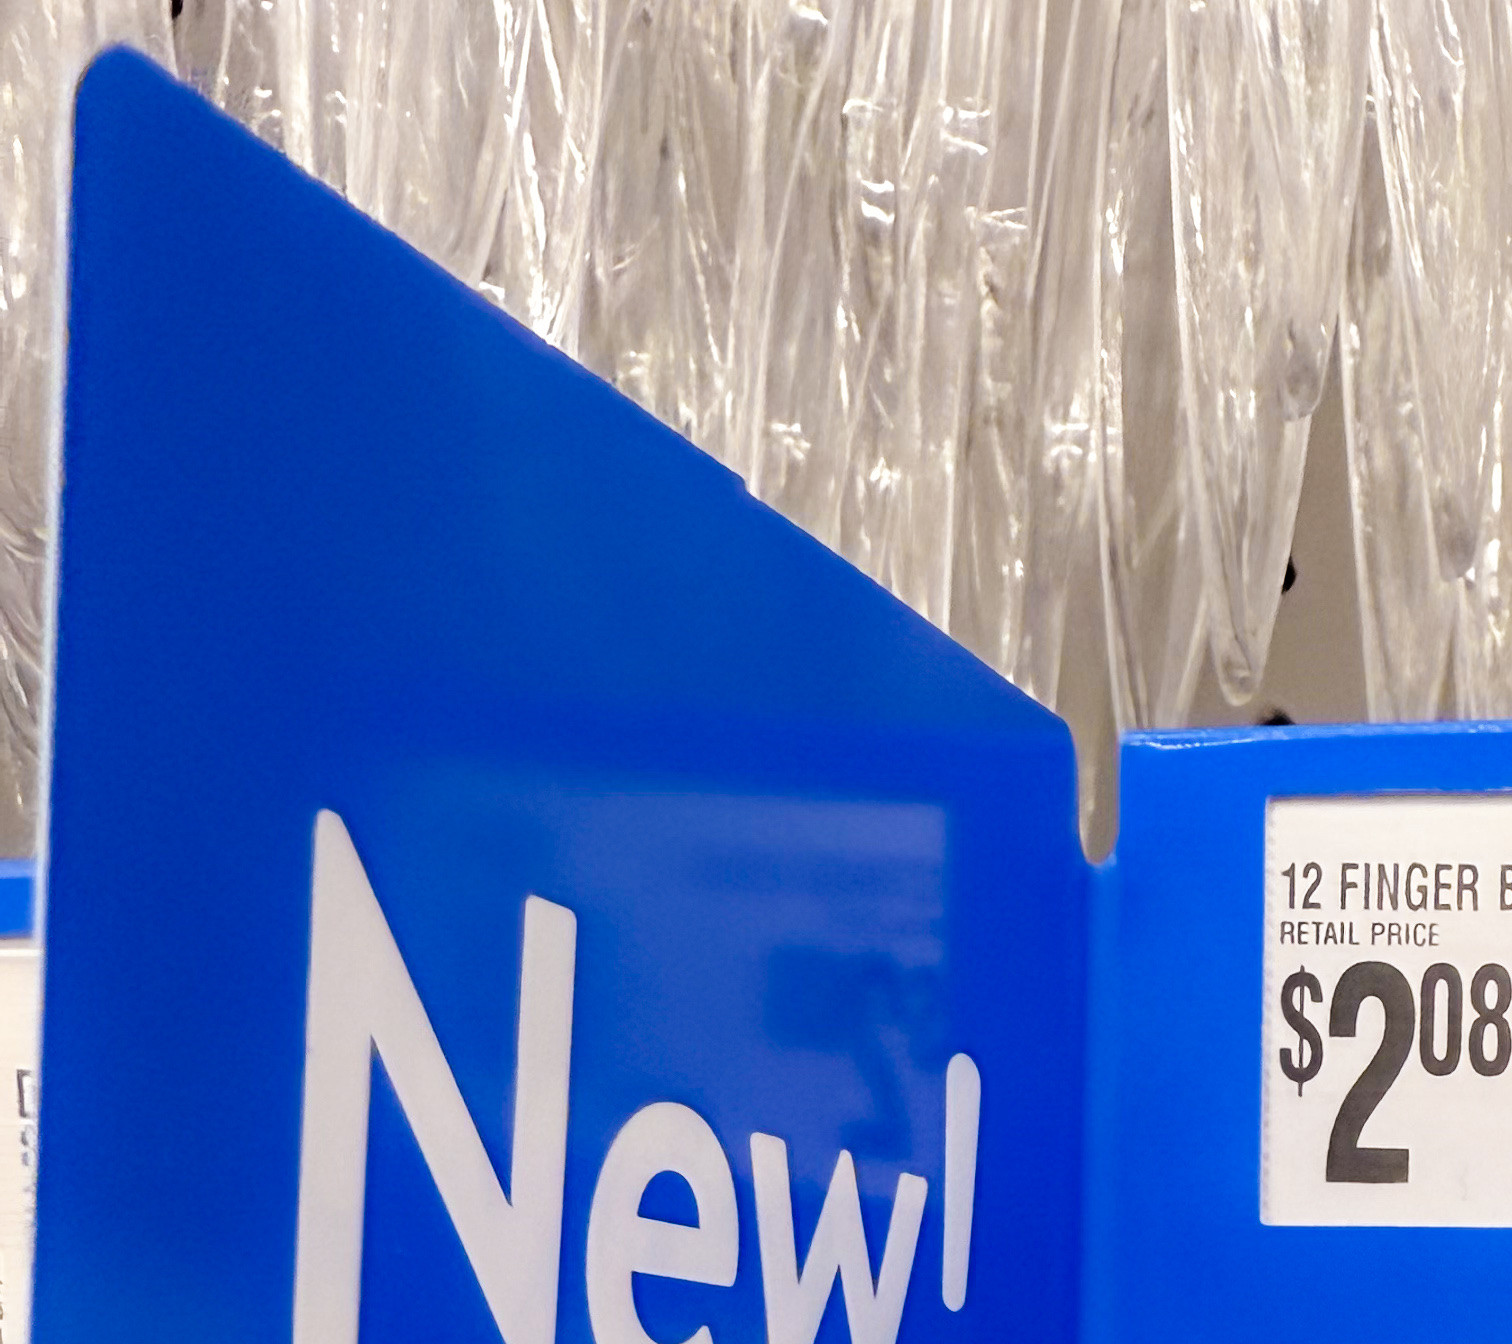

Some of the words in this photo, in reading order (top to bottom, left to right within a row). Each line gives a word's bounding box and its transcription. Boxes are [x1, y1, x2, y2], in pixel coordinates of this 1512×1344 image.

[1279, 861, 1324, 913] 12
[1339, 862, 1480, 913] FINGER
[1279, 921, 1360, 947] RETAIL
[1370, 922, 1440, 947] PRICE
